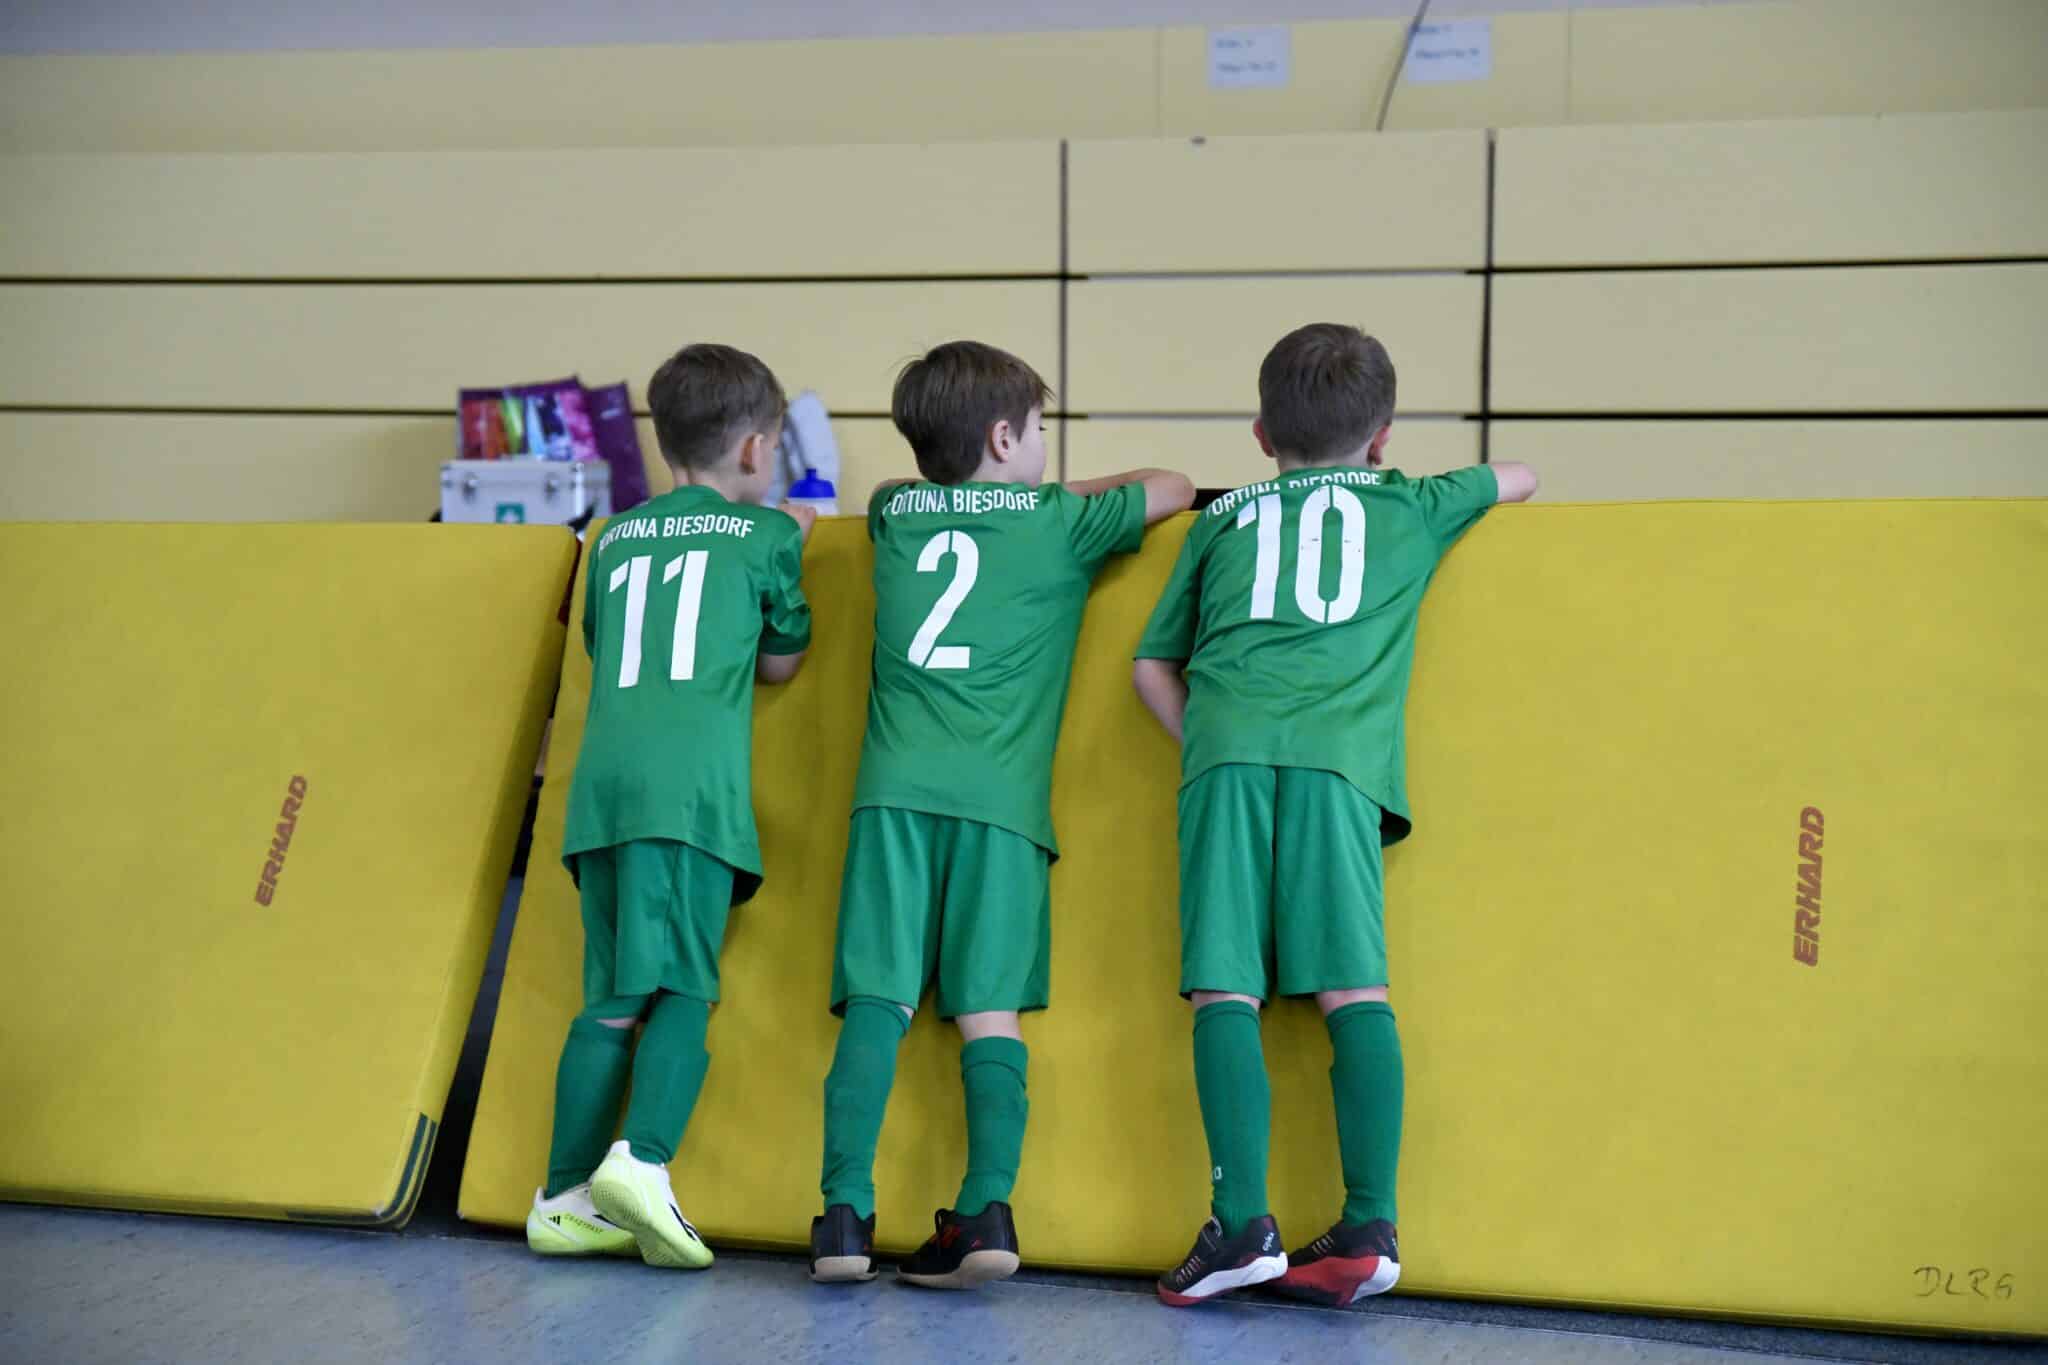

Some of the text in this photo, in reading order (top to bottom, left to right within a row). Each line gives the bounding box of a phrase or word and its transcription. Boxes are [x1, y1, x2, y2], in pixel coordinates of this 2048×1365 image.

[662, 514, 755, 538] BIESDORF
[952, 489, 1039, 514] BIESDORF
[1237, 484, 1366, 624] 10
[609, 550, 709, 689] 11
[907, 530, 980, 669] 2
[255, 775, 308, 907] ERHARD
[1793, 806, 1825, 967] ERHARD
[1913, 1265, 2015, 1301] DLRG
